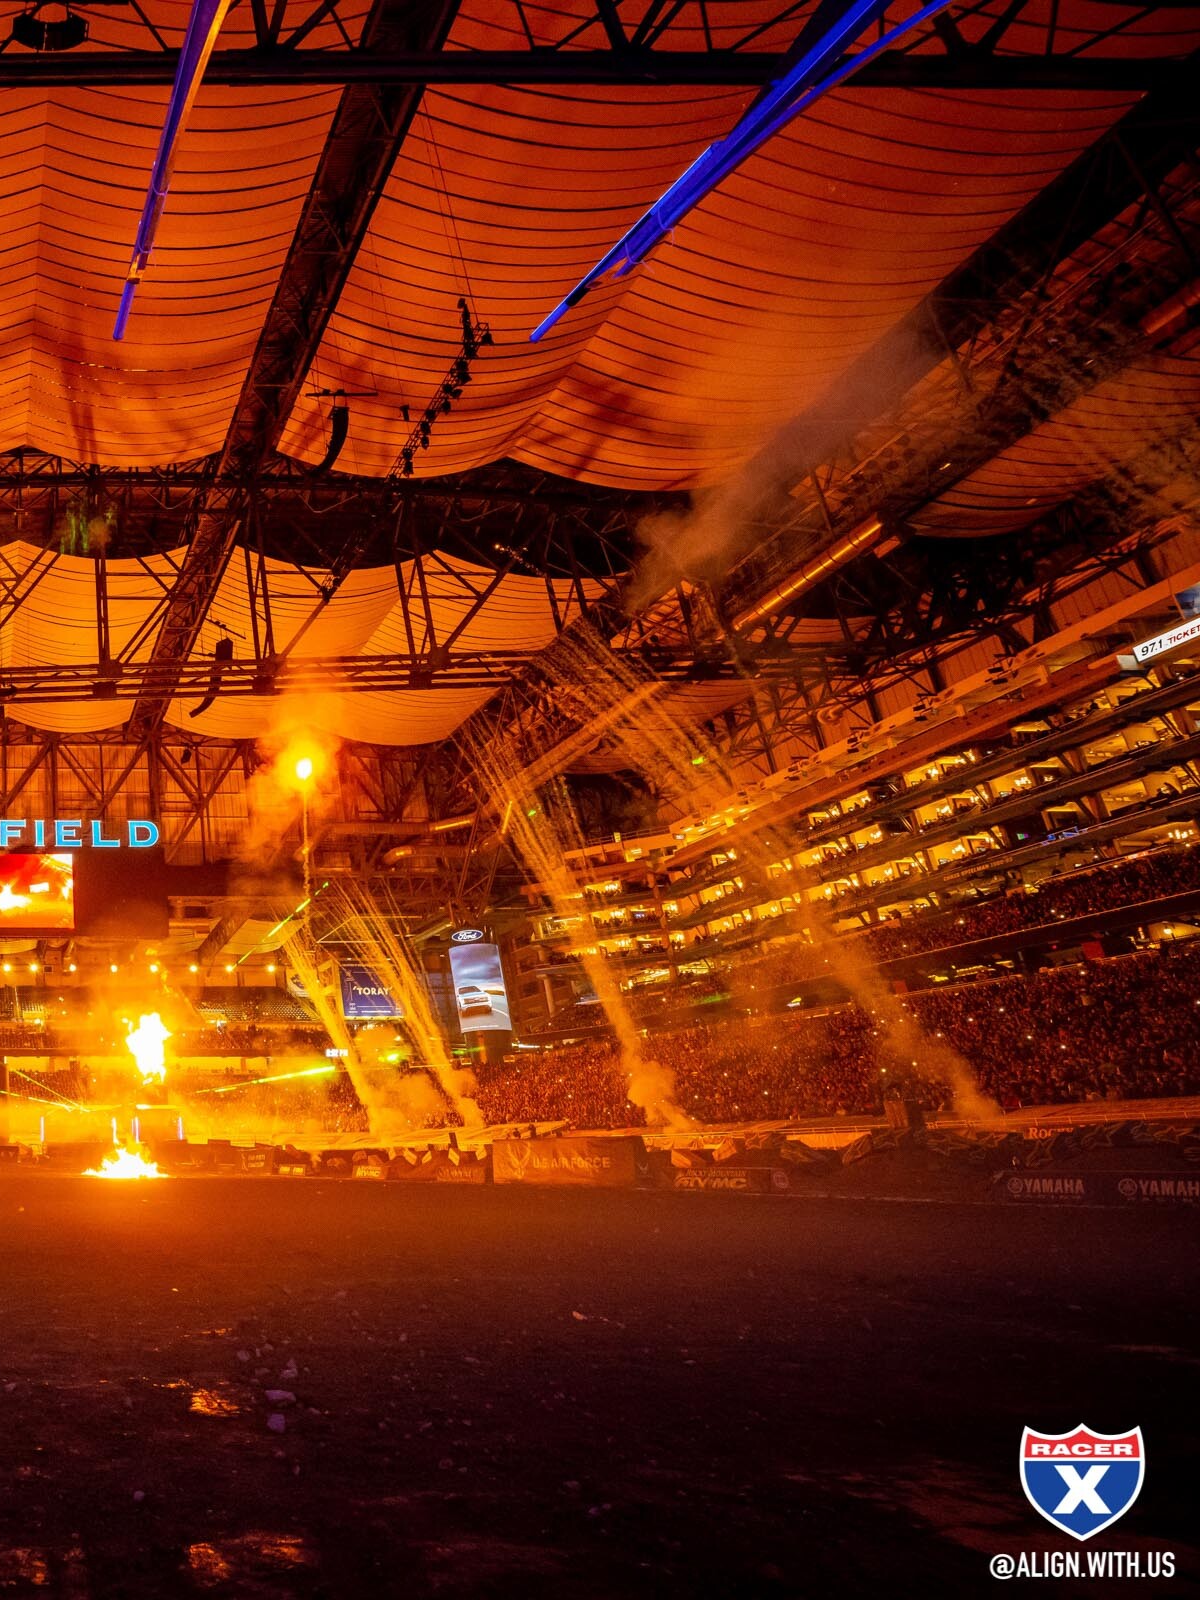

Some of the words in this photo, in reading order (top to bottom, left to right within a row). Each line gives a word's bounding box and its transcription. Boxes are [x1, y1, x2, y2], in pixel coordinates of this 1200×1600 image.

[1141, 639, 1163, 656] 97.1
[457, 930, 478, 941] Ford
[571, 1156, 611, 1169] FORCE
[1023, 1178, 1085, 1194] YAMAHA
[1139, 1179, 1200, 1197] YAMAH
